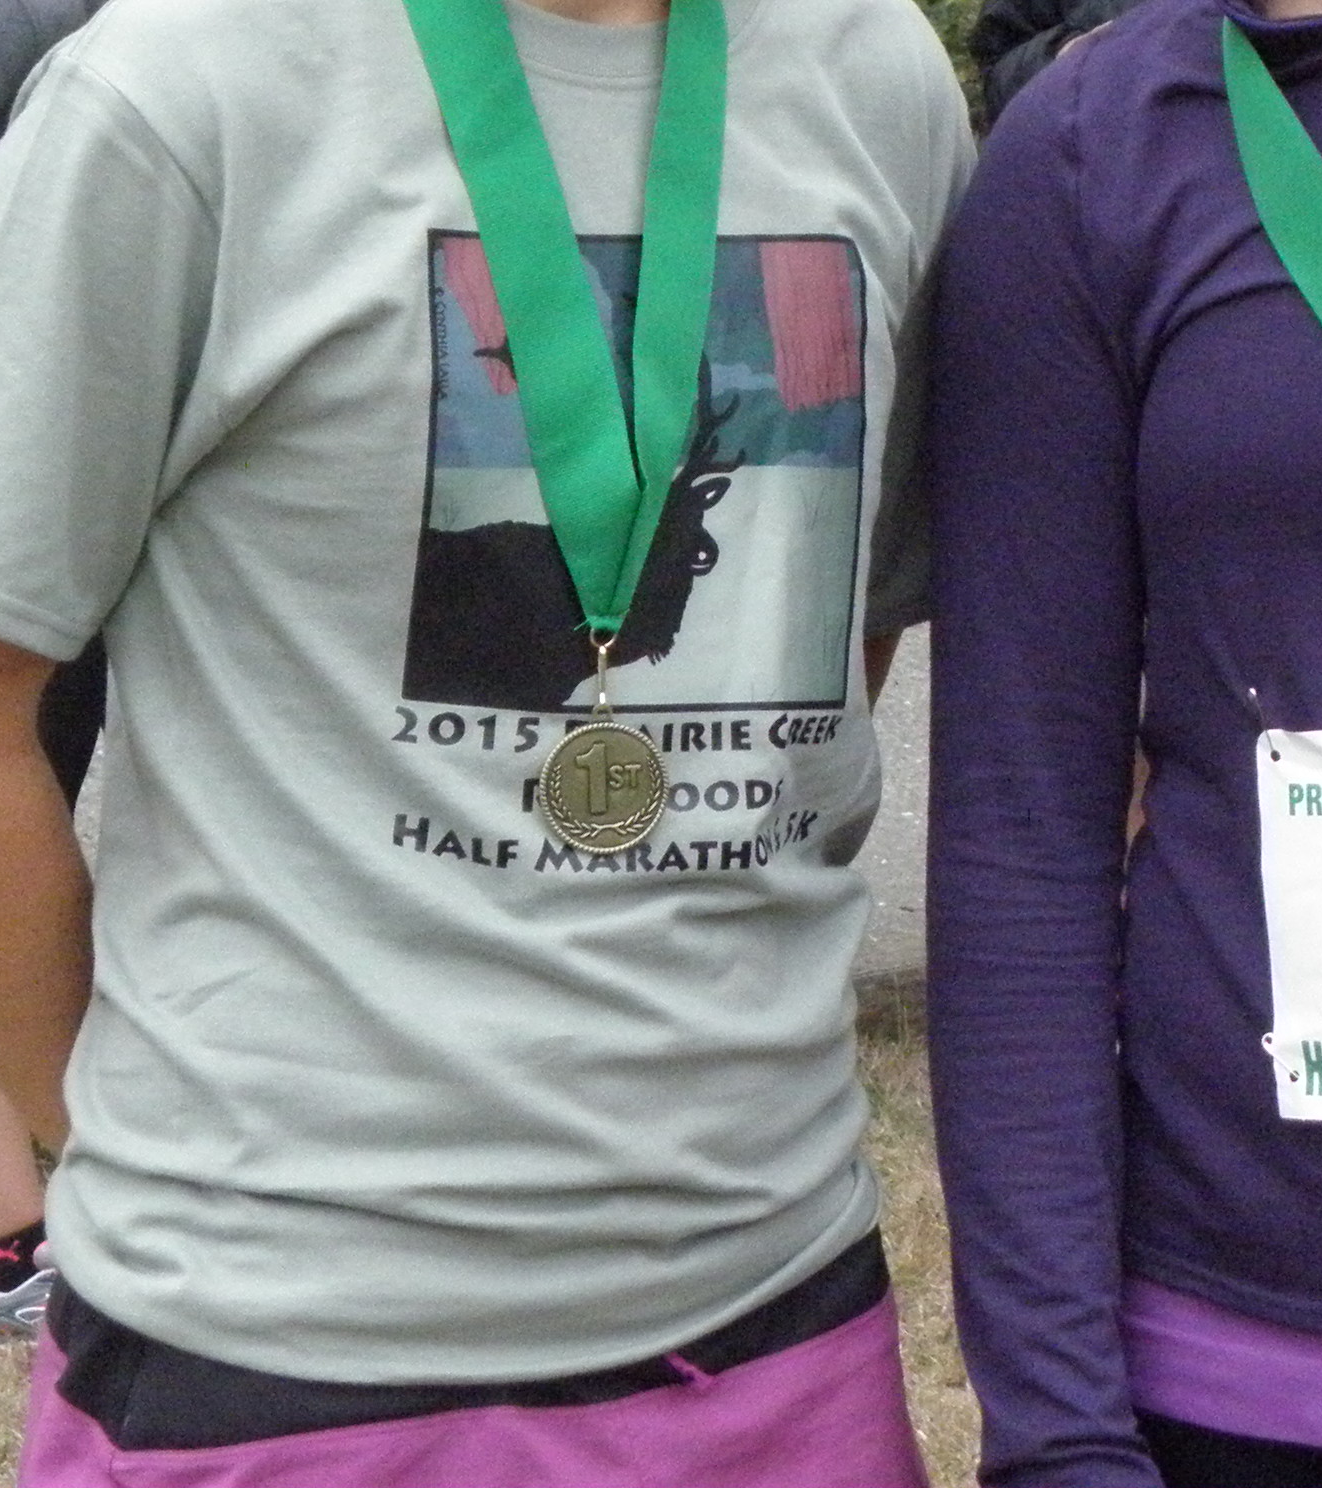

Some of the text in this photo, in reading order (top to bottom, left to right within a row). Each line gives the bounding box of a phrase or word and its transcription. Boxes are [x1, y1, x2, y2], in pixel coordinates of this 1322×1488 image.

[391, 706, 844, 754] 2015 IRIE CREEK
[392, 813, 519, 869] HALF
